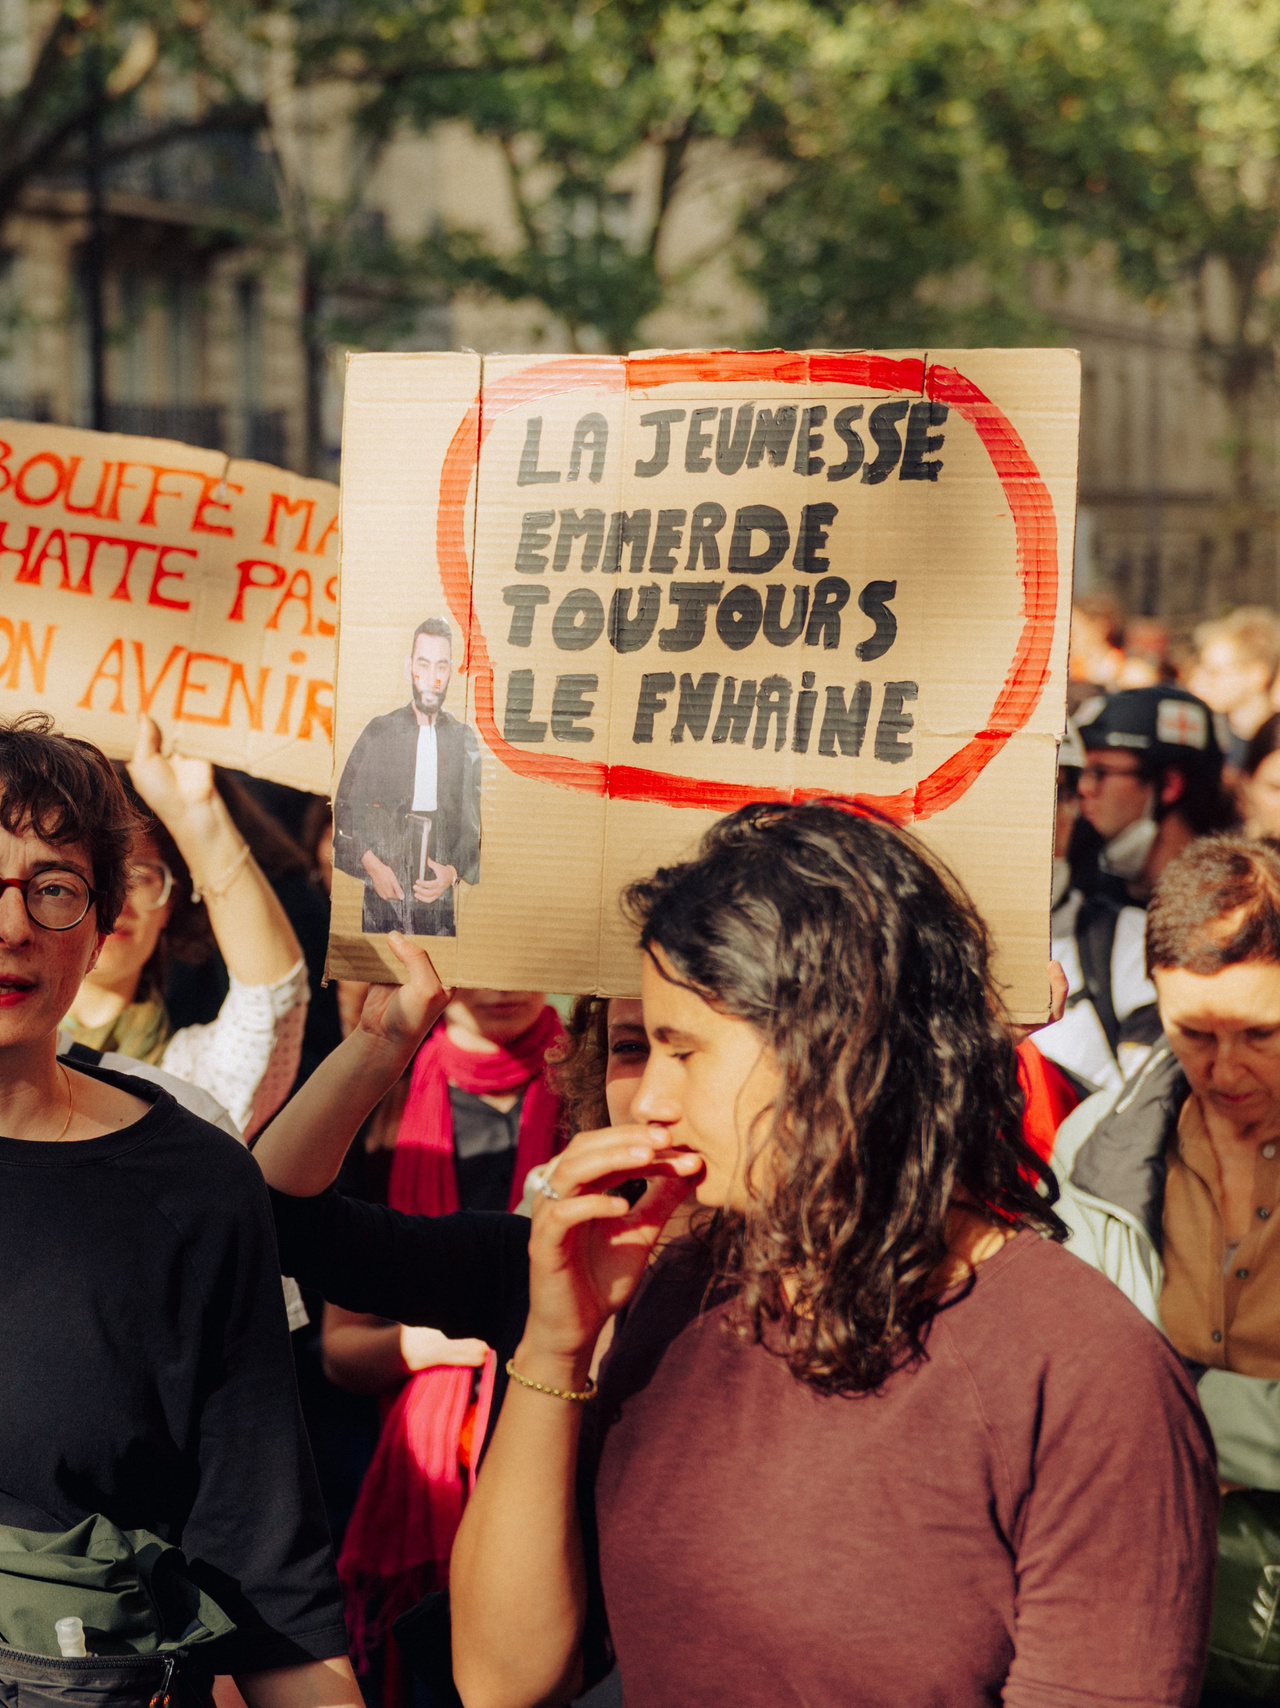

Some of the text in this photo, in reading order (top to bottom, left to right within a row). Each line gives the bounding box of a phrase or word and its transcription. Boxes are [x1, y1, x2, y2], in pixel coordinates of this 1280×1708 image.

[516, 400, 951, 486] LA JEUNESSE
[514, 501, 840, 575] EMMERDE
[501, 575, 898, 663] TOUJOURS
[502, 668, 600, 744] LE
